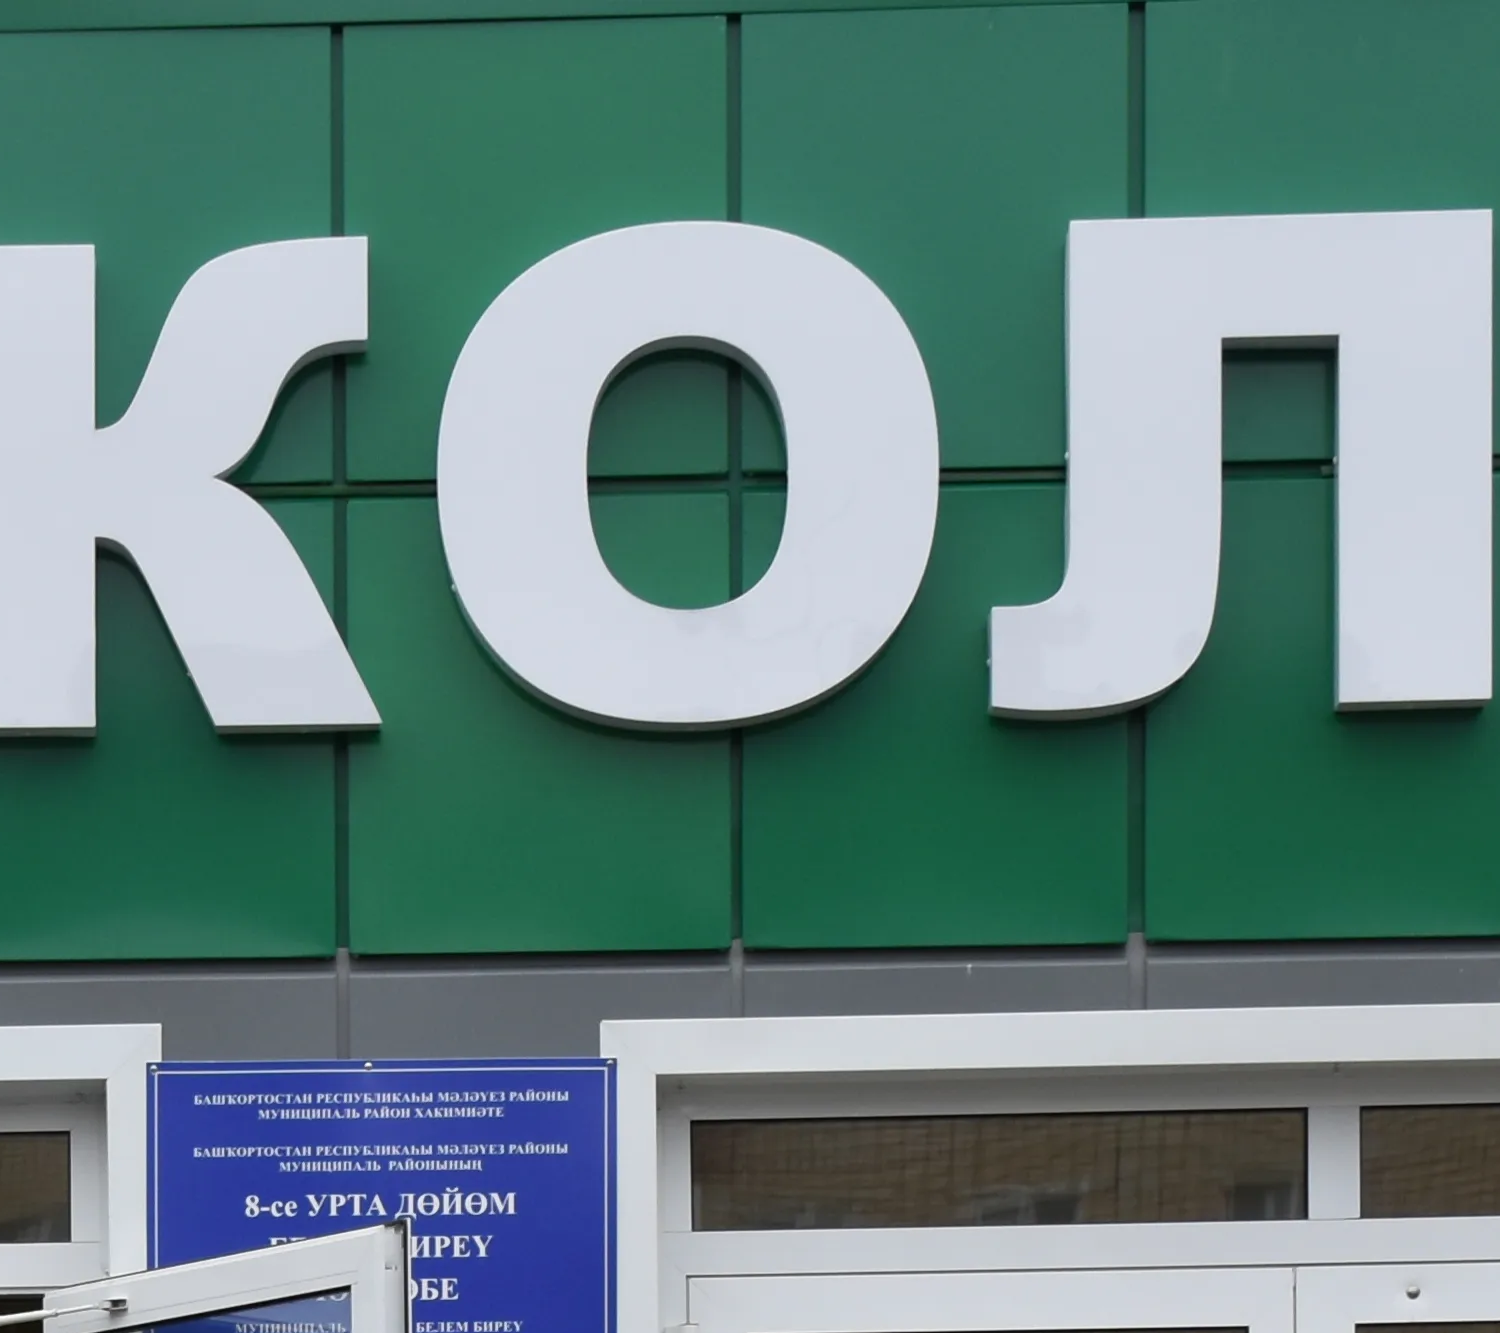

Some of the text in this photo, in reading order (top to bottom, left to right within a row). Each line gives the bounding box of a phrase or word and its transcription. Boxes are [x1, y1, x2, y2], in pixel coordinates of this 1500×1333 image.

[193, 1093, 312, 1106] БАШҠОРТОСТАН
[316, 1092, 433, 1104] РЕСПУБЛИКАҺЫ
[509, 1089, 569, 1102] РАЙОНЫ
[258, 1106, 504, 1120] МУНИЦИПАЛЬ РАЙОН ХАКИМИӘТЕ
[192, 1146, 312, 1158] БАШҠОРТОСТАН
[316, 1144, 432, 1157] РЕСПУБЛИКАҺЫ
[508, 1141, 568, 1155] РАЙОНЫ
[279, 1158, 482, 1173] МУНИЦИПАЛЬ РАЙОНЫНЫҢ
[245, 1187, 516, 1219] 8-се УРТА ДӨЙӨМ
[412, 1235, 493, 1259] ИРЕҮ
[416, 1321, 469, 1333] БЕЛЕМ
[473, 1321, 523, 1333] БИРЕҮ
